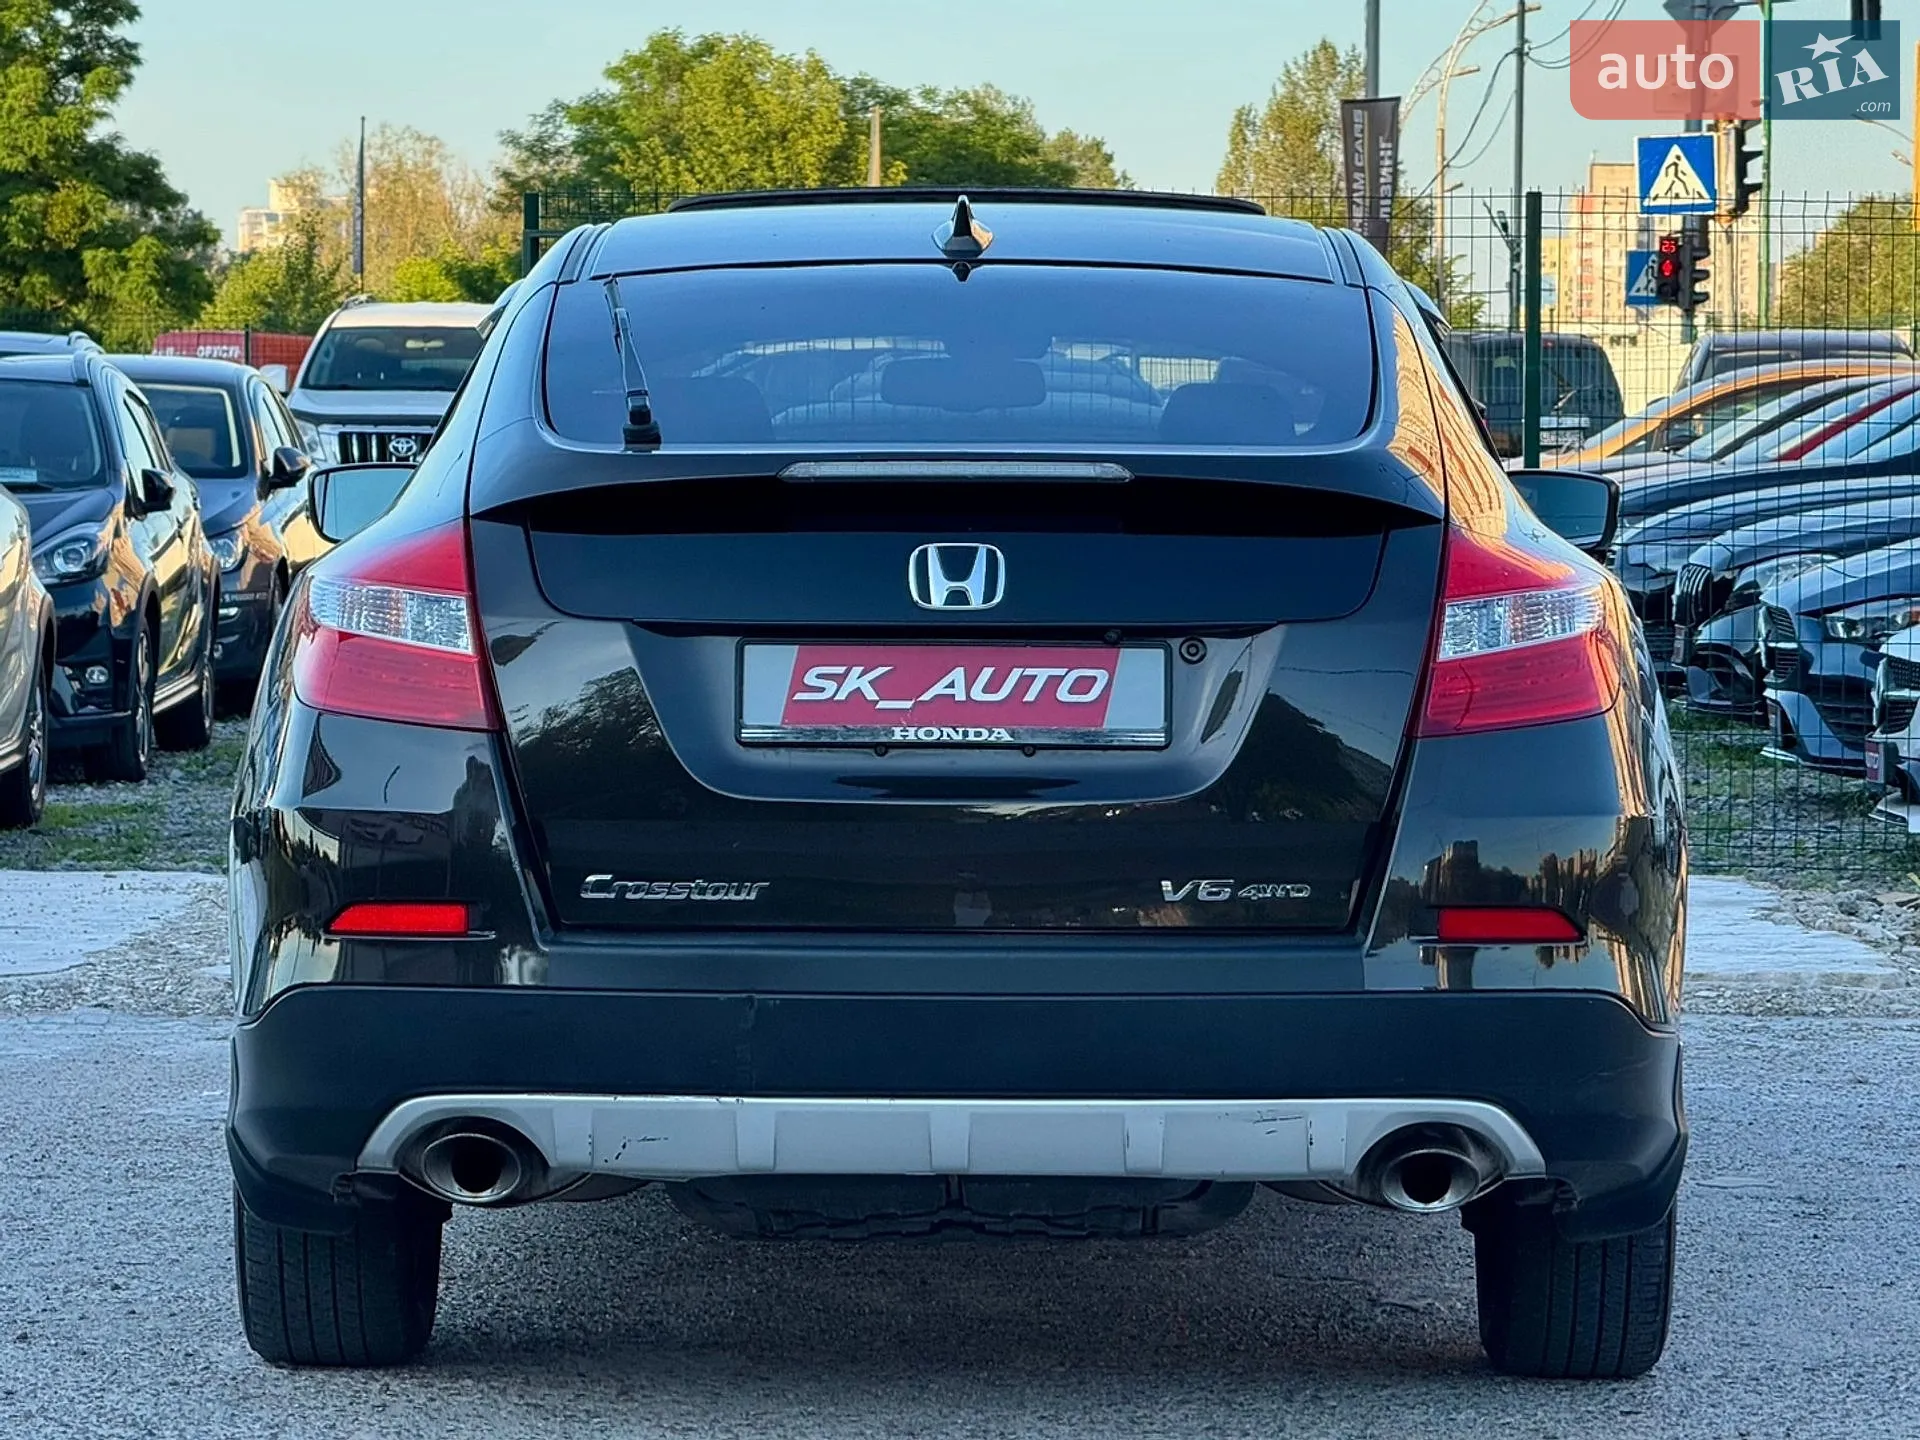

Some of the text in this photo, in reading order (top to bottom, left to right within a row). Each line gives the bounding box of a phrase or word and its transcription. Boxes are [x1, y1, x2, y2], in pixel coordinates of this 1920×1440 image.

[792, 666, 1113, 709] SK_AUTO
[891, 727, 1015, 742] HONDA
[580, 874, 770, 900] Crosstour
[1160, 879, 1312, 901] V6 4WD
